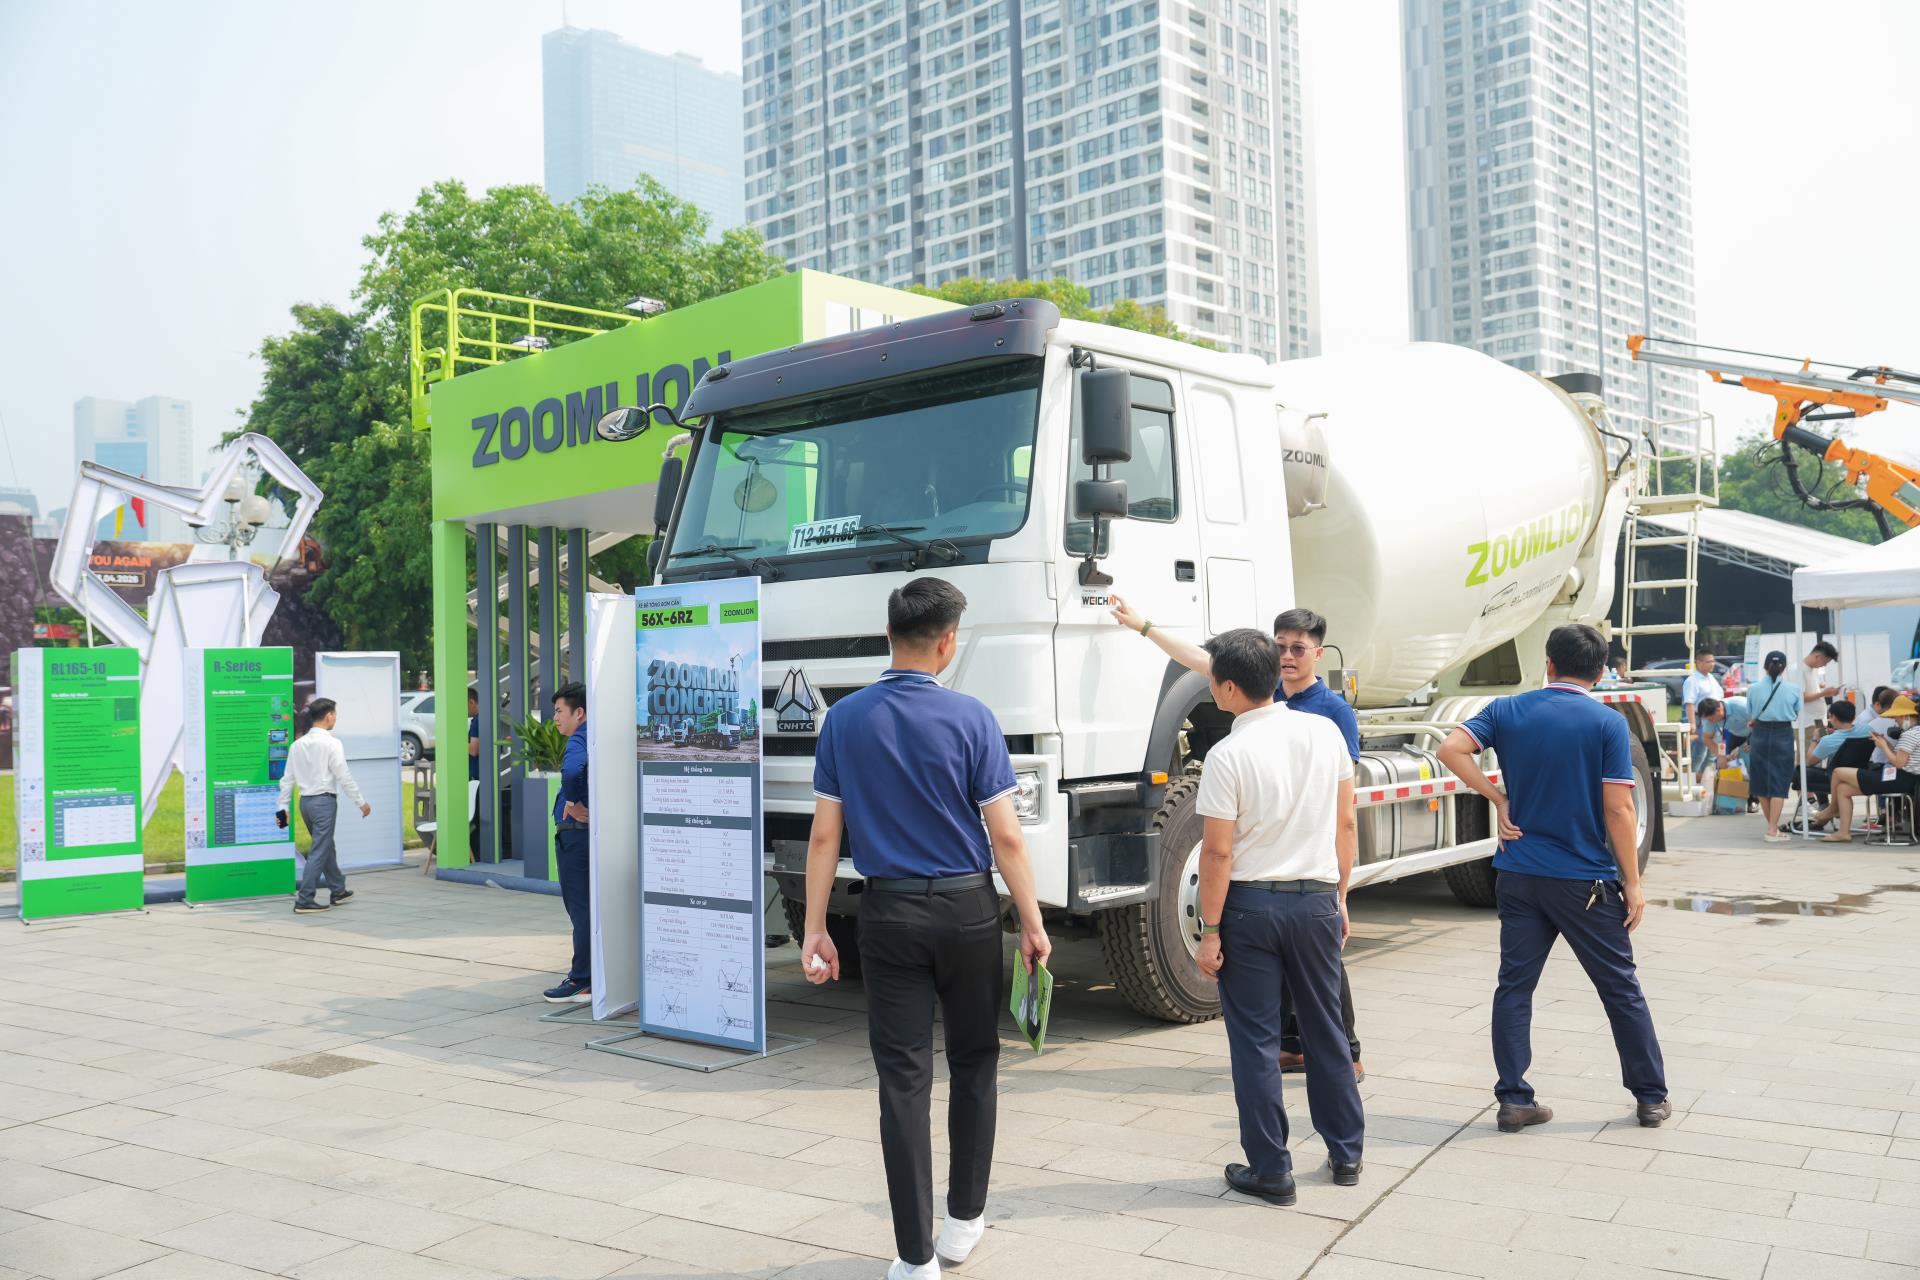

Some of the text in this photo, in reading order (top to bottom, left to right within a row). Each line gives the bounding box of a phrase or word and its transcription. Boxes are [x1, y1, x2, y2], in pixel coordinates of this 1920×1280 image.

[114, 555, 151, 567] AGAIN
[641, 610, 693, 626] 56X-6RZ
[724, 607, 754, 617] ZOOMLION
[51, 662, 106, 675] RL165-10
[213, 660, 262, 673] R-Series
[648, 659, 739, 692] ZOOMLION
[648, 686, 740, 715] CONCRETE
[778, 722, 813, 730] CNHTC
